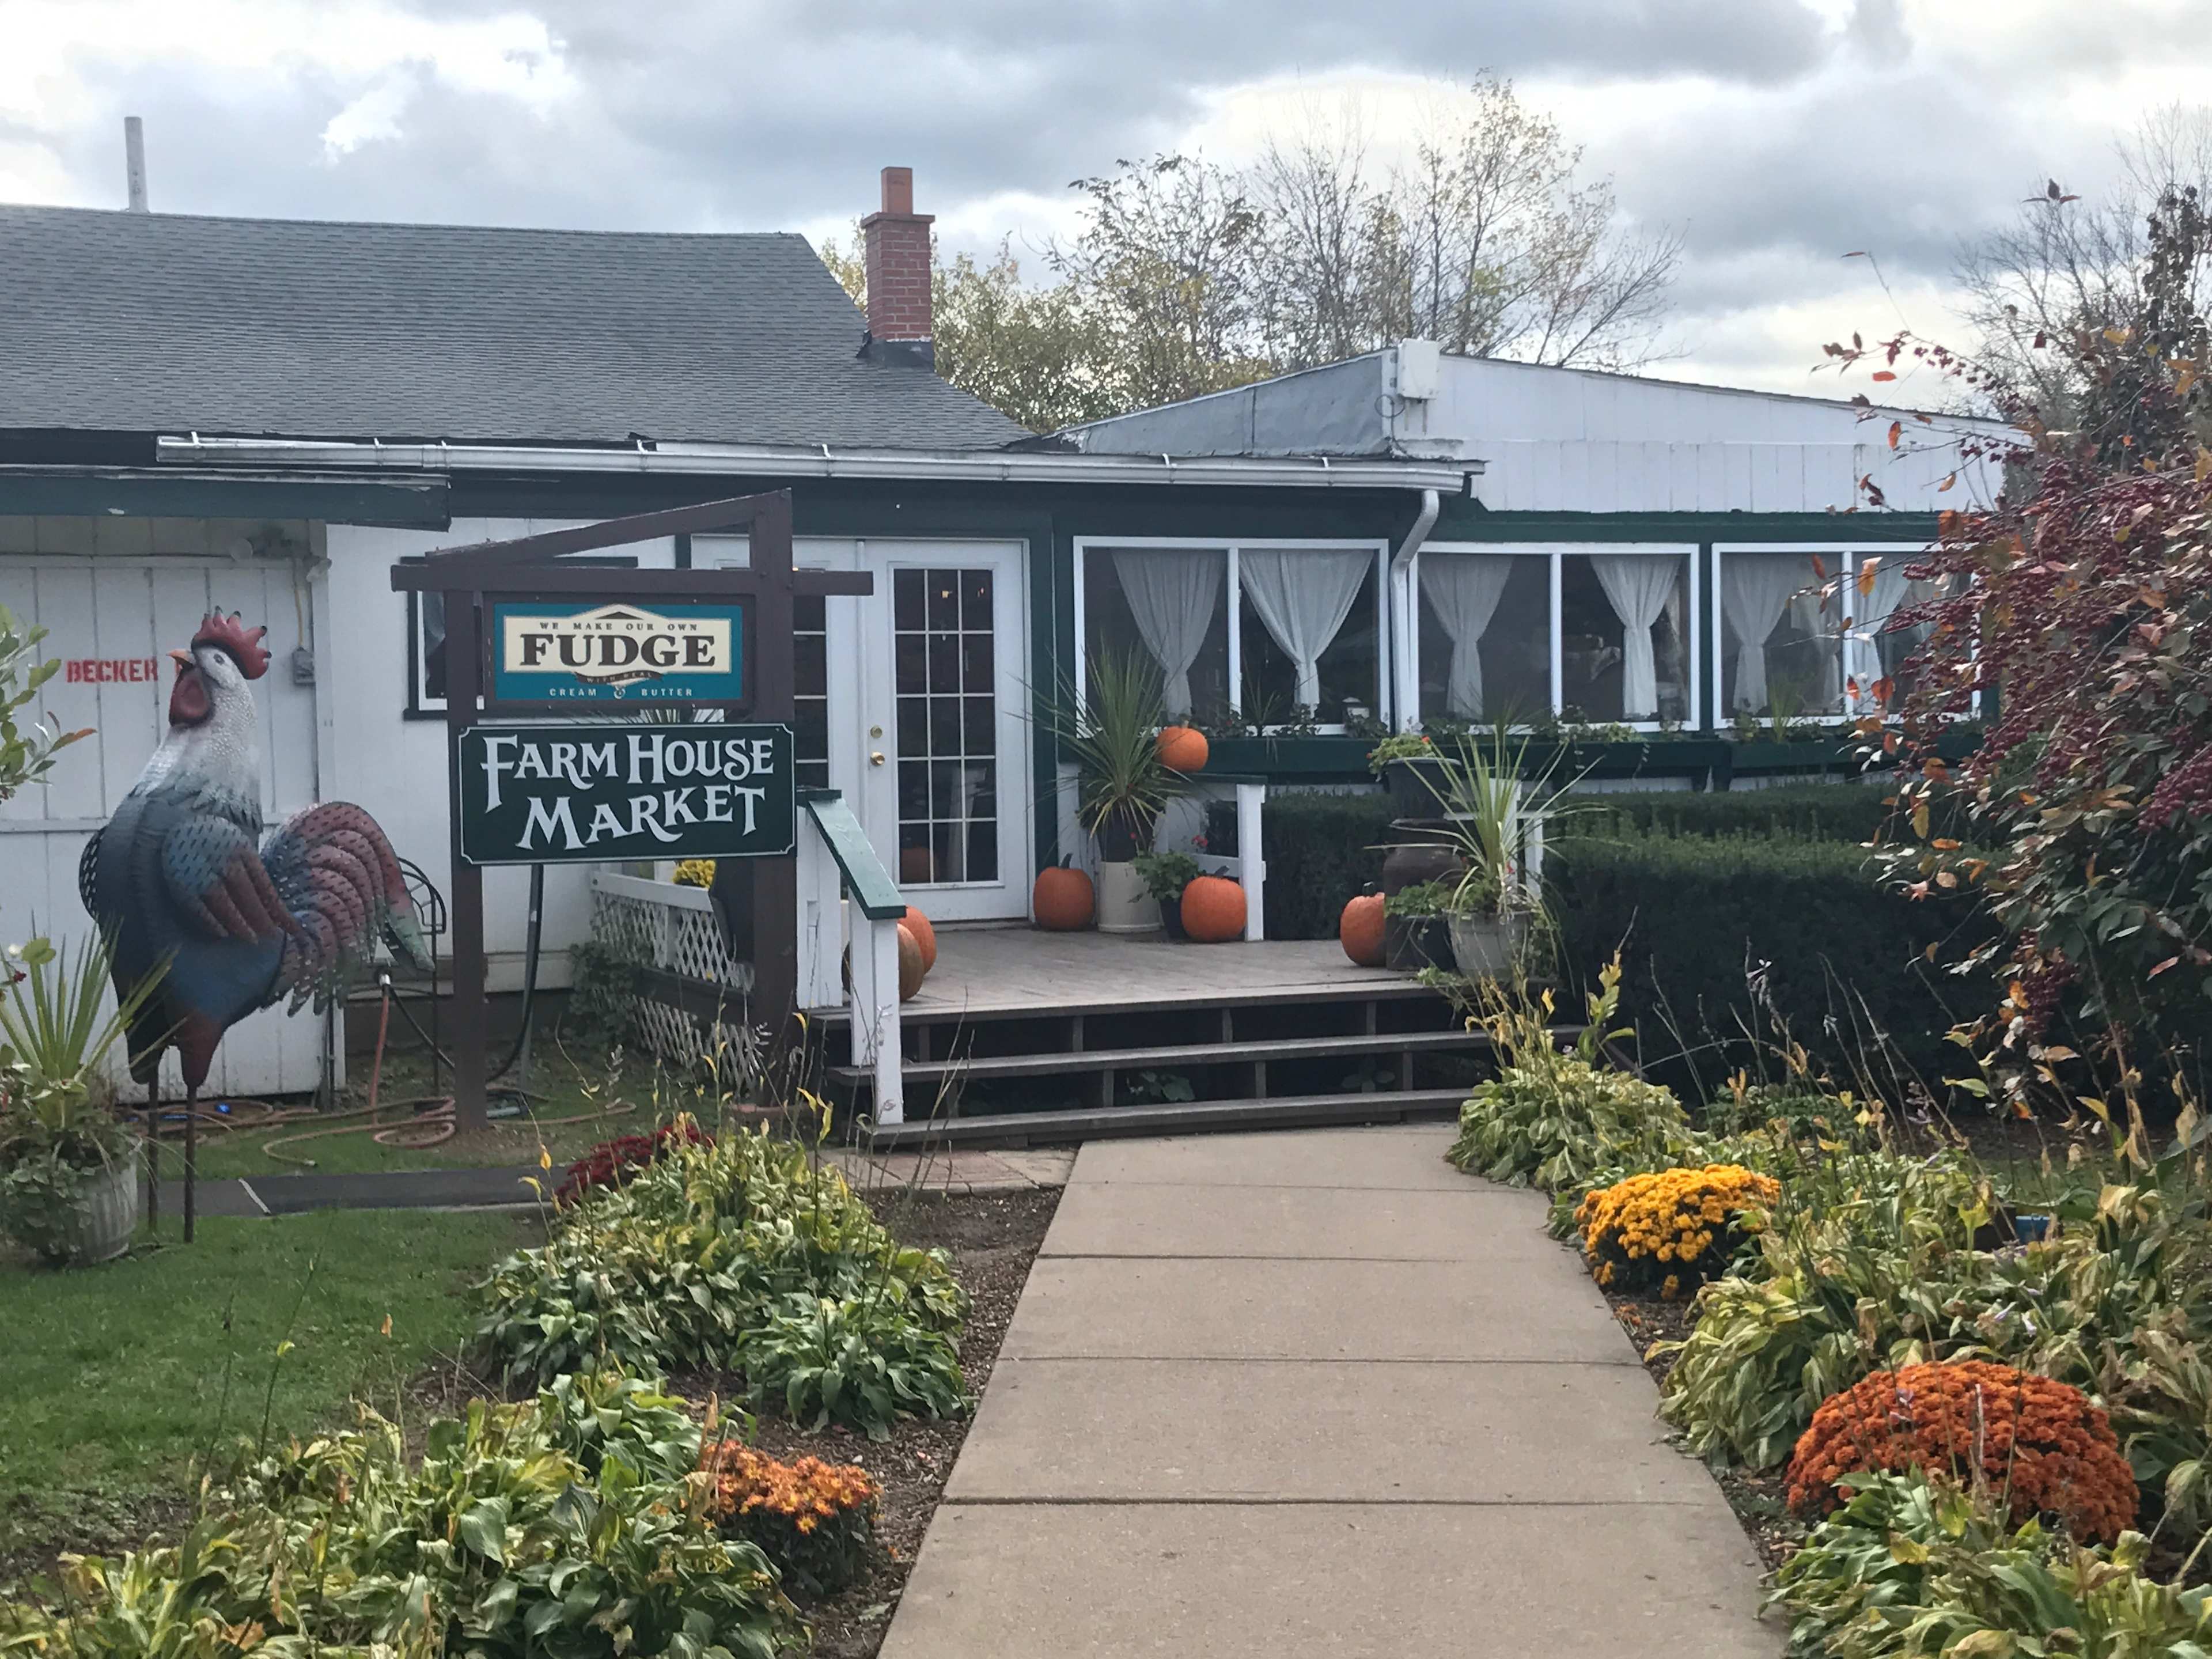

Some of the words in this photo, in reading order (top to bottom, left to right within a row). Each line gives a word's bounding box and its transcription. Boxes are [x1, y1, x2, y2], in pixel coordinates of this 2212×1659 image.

[520, 634, 715, 667] FUDGE
[66, 658, 158, 683] BECKER
[550, 688, 597, 696] CREAM
[641, 688, 692, 696] BUTTER
[480, 734, 619, 813] FARM
[626, 734, 774, 784] HOUSE
[516, 784, 766, 851] MARKET
